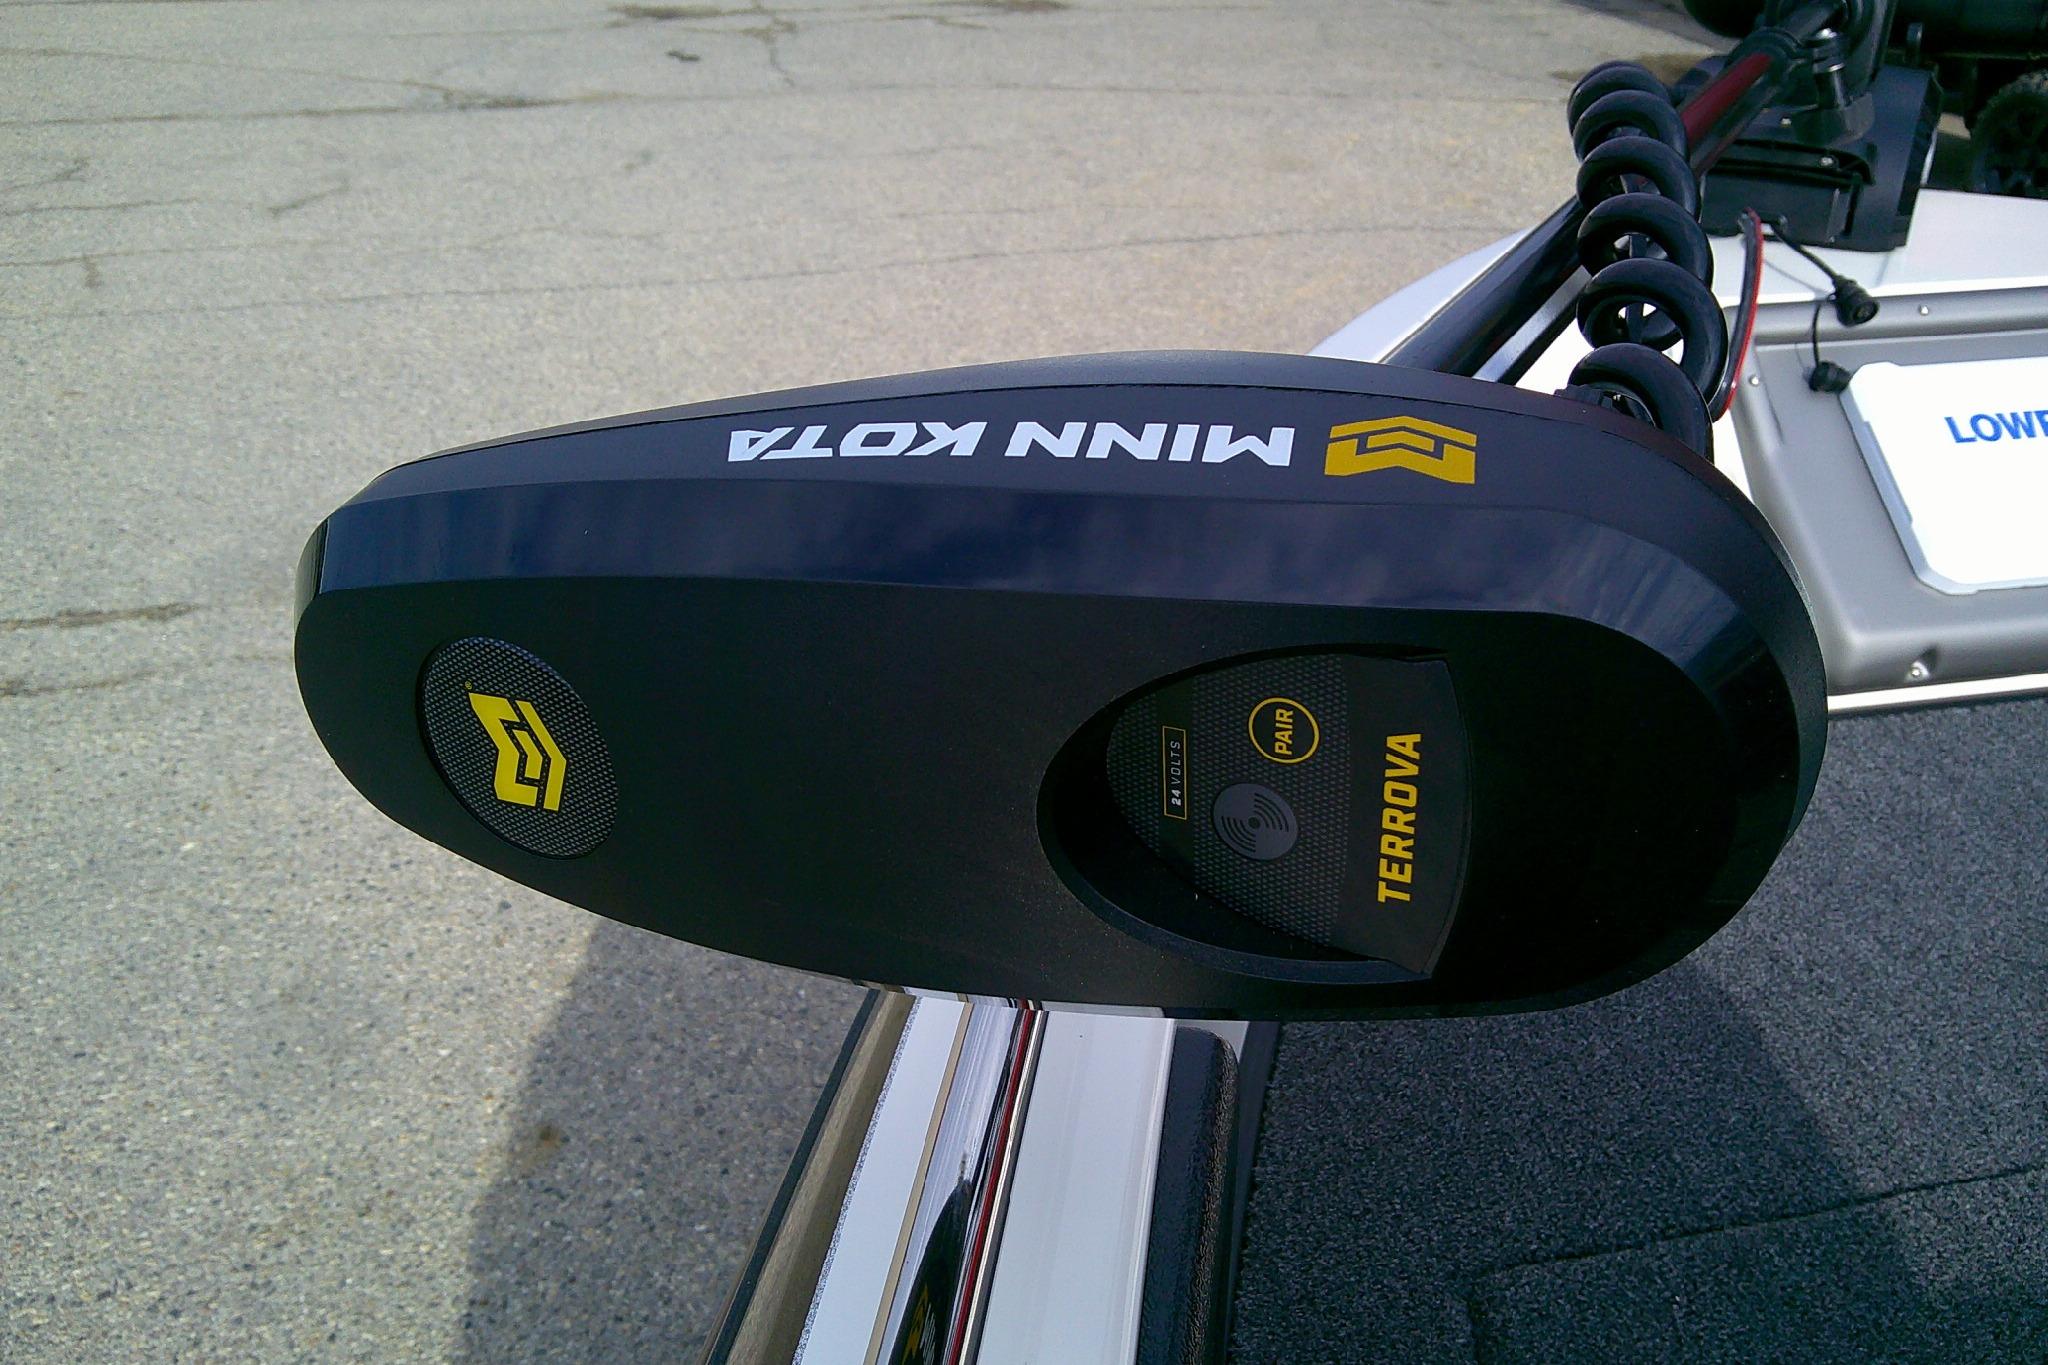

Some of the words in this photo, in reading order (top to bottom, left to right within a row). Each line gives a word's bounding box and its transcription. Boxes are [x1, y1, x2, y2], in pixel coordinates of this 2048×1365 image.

[727, 421, 988, 462] KOTA
[1004, 421, 1296, 467] MINN
[1274, 708, 1293, 755] PAIR
[1170, 740, 1181, 785] VOLTS
[1171, 789, 1182, 806] 24
[1377, 733, 1422, 903] TERROVA
